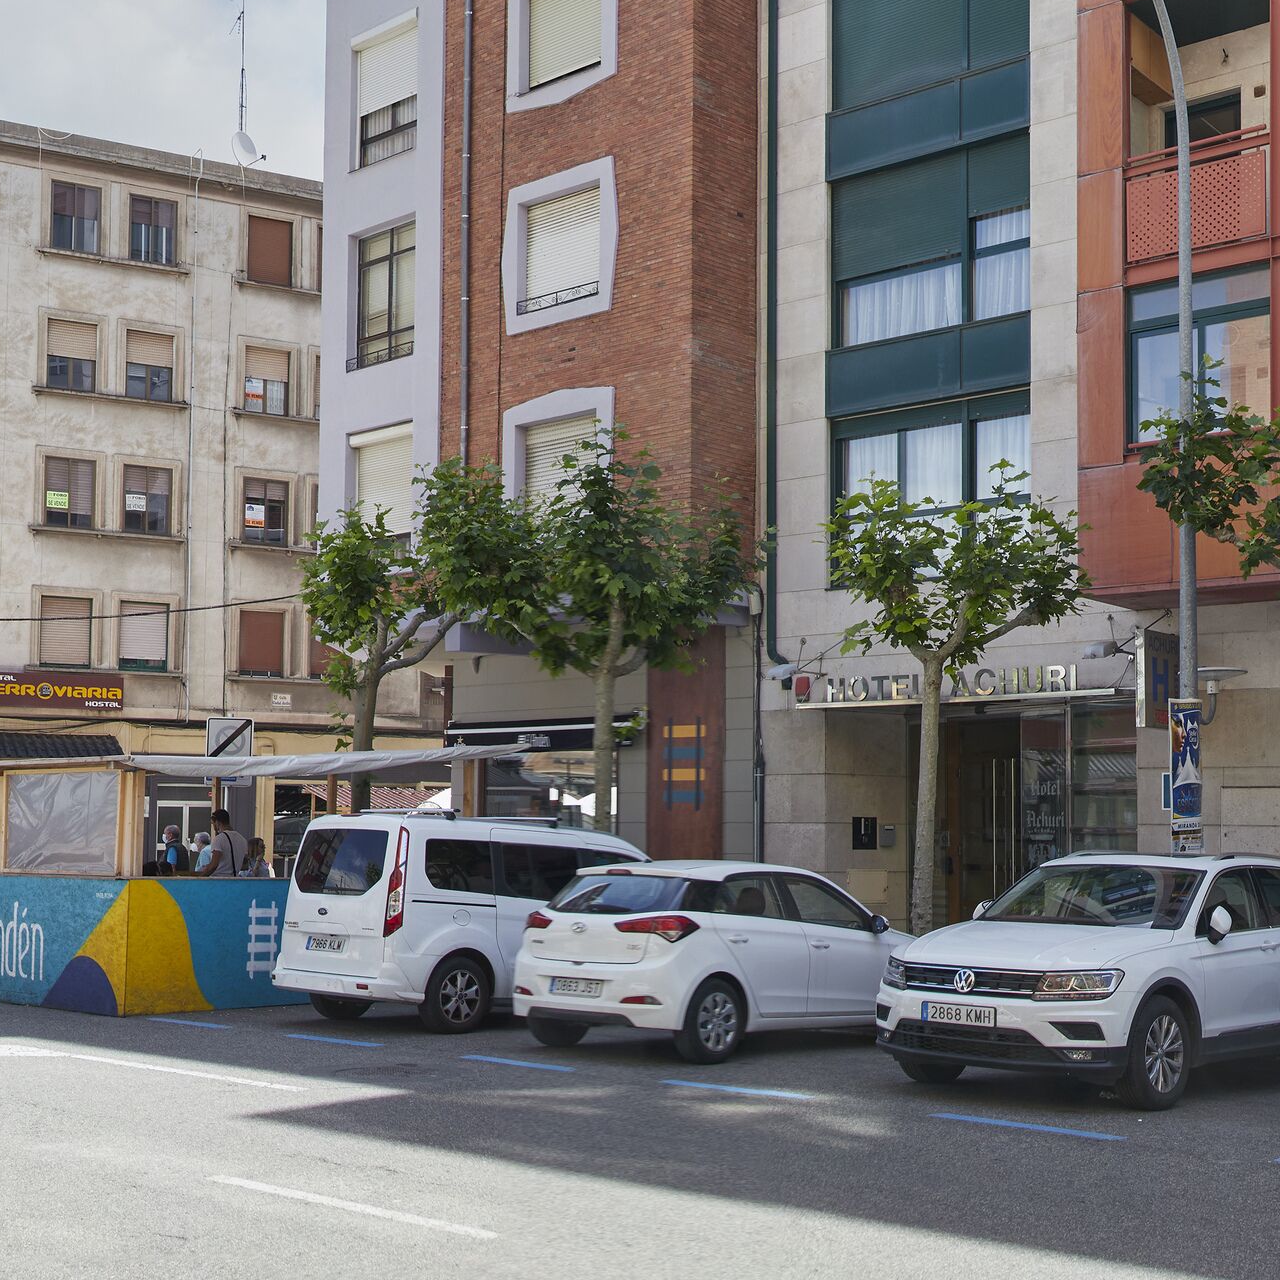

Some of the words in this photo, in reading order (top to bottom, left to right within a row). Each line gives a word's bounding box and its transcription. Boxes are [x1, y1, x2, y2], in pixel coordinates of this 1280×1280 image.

[827, 674, 923, 702] HOTEL
[950, 664, 1077, 697] ACHURI
[1152, 657, 1168, 704] H
[85, 700, 121, 708] HOSTAL
[1031, 780, 1061, 796] Hotel
[1026, 811, 1064, 827] Achuri
[931, 1006, 961, 1021] 2868
[966, 1008, 991, 1024] KMH
